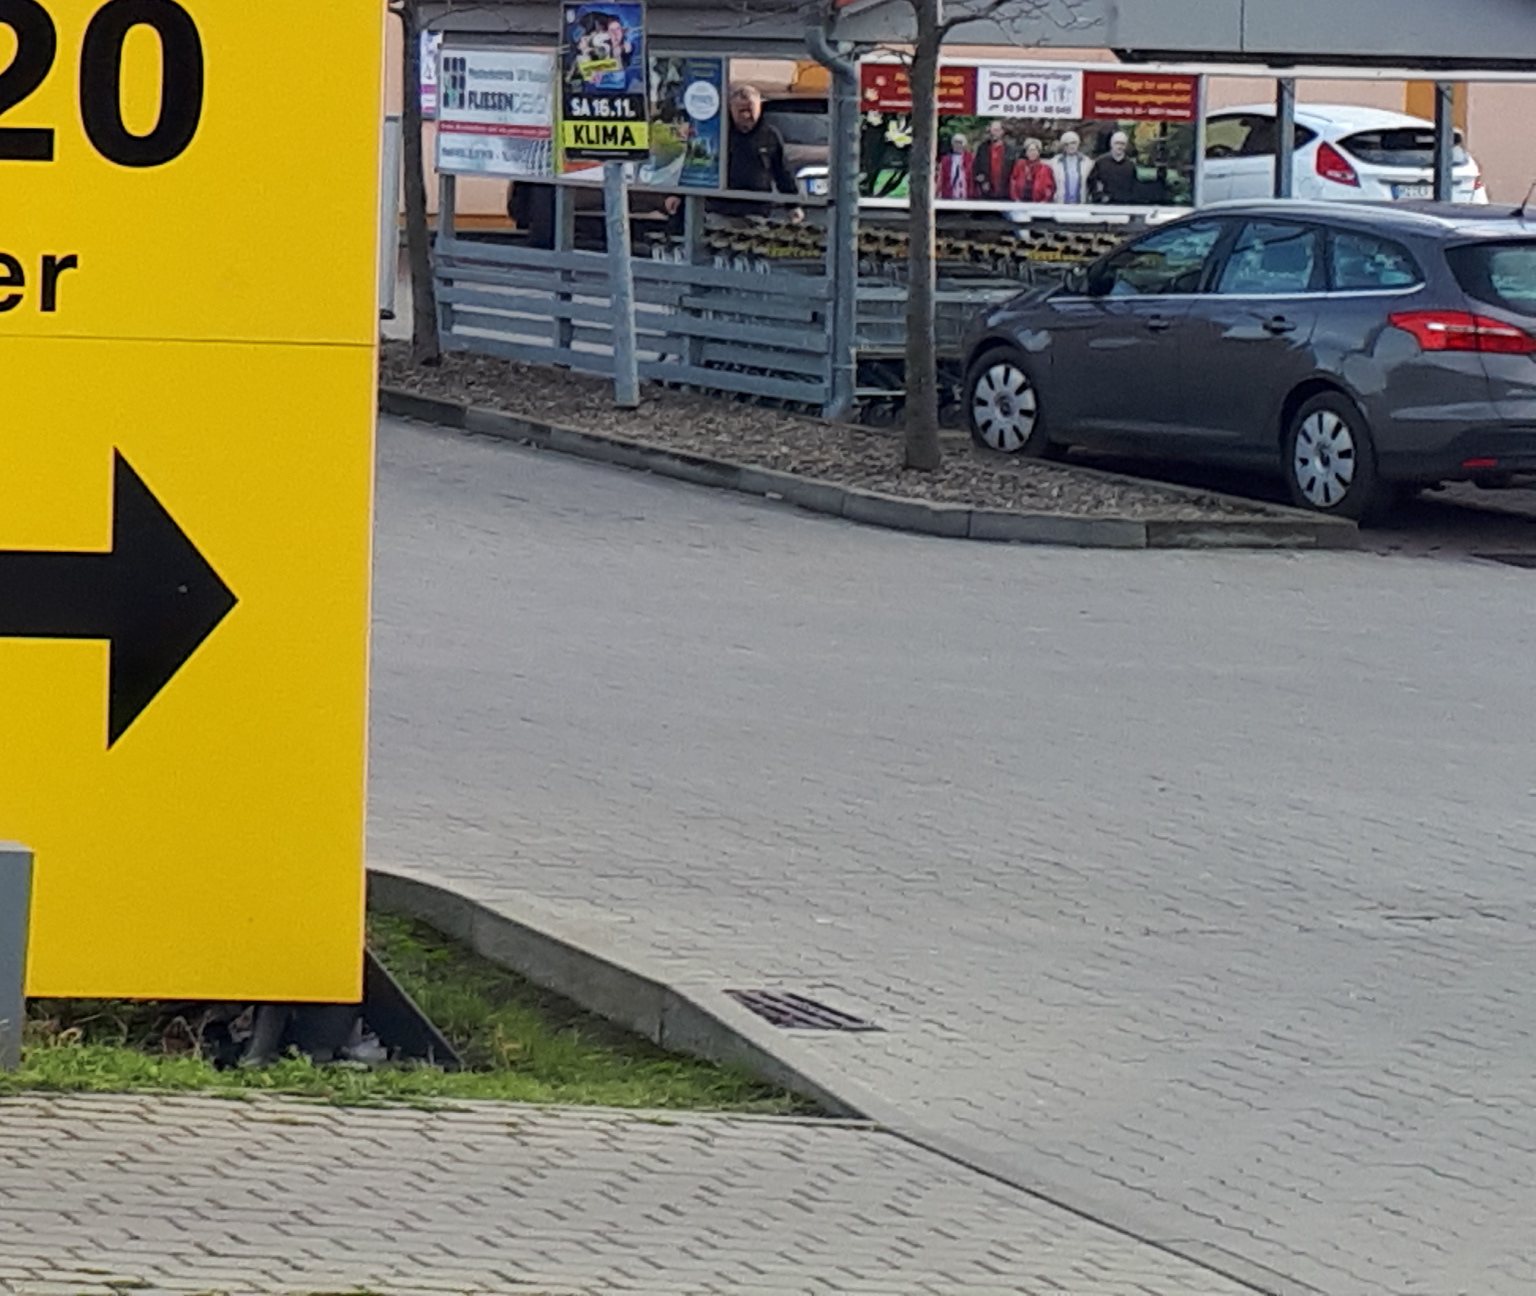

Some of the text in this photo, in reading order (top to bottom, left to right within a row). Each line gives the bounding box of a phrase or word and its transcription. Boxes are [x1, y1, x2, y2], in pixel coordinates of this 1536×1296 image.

[988, 81, 1048, 102] DORI
[571, 98, 636, 117] SA 16.11.
[573, 124, 636, 146] KLIMA
